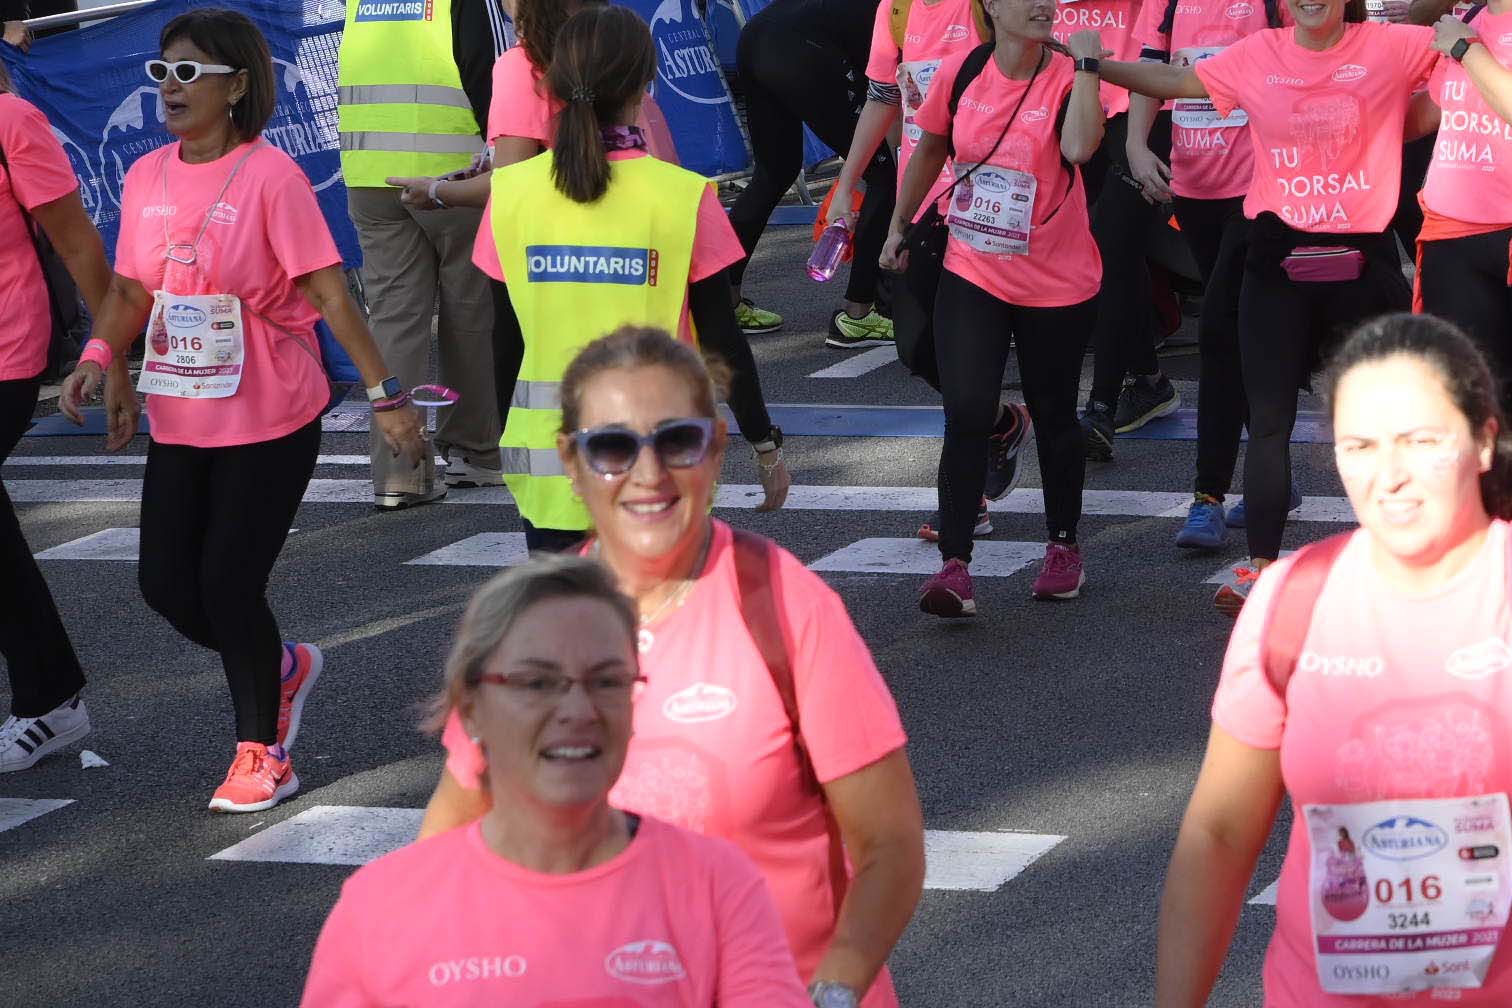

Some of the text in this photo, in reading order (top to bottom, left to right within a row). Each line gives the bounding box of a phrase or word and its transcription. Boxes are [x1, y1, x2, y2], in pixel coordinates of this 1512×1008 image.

[358, 2, 423, 17] VOLUNTARIS
[668, 29, 700, 43] CENTRAL
[1444, 81, 1466, 101] TU
[1176, 128, 1226, 149] SUMA
[1271, 146, 1299, 170] TU
[1439, 139, 1495, 163] SUMA
[974, 196, 1001, 212] 016
[1281, 201, 1349, 225] SUMA
[972, 212, 995, 225] 22263
[171, 336, 202, 351] 016
[176, 355, 196, 365] 2806
[1302, 653, 1383, 677] OYSHO
[1375, 875, 1442, 904] 016
[1388, 912, 1431, 930] 3244
[1335, 938, 1388, 950] CARRERA
[1389, 939, 1404, 949] DE
[1407, 938, 1422, 949] LA
[1426, 935, 1468, 948] MUJER
[429, 956, 527, 986] OYSHO
[1333, 964, 1391, 981] OYSHO
